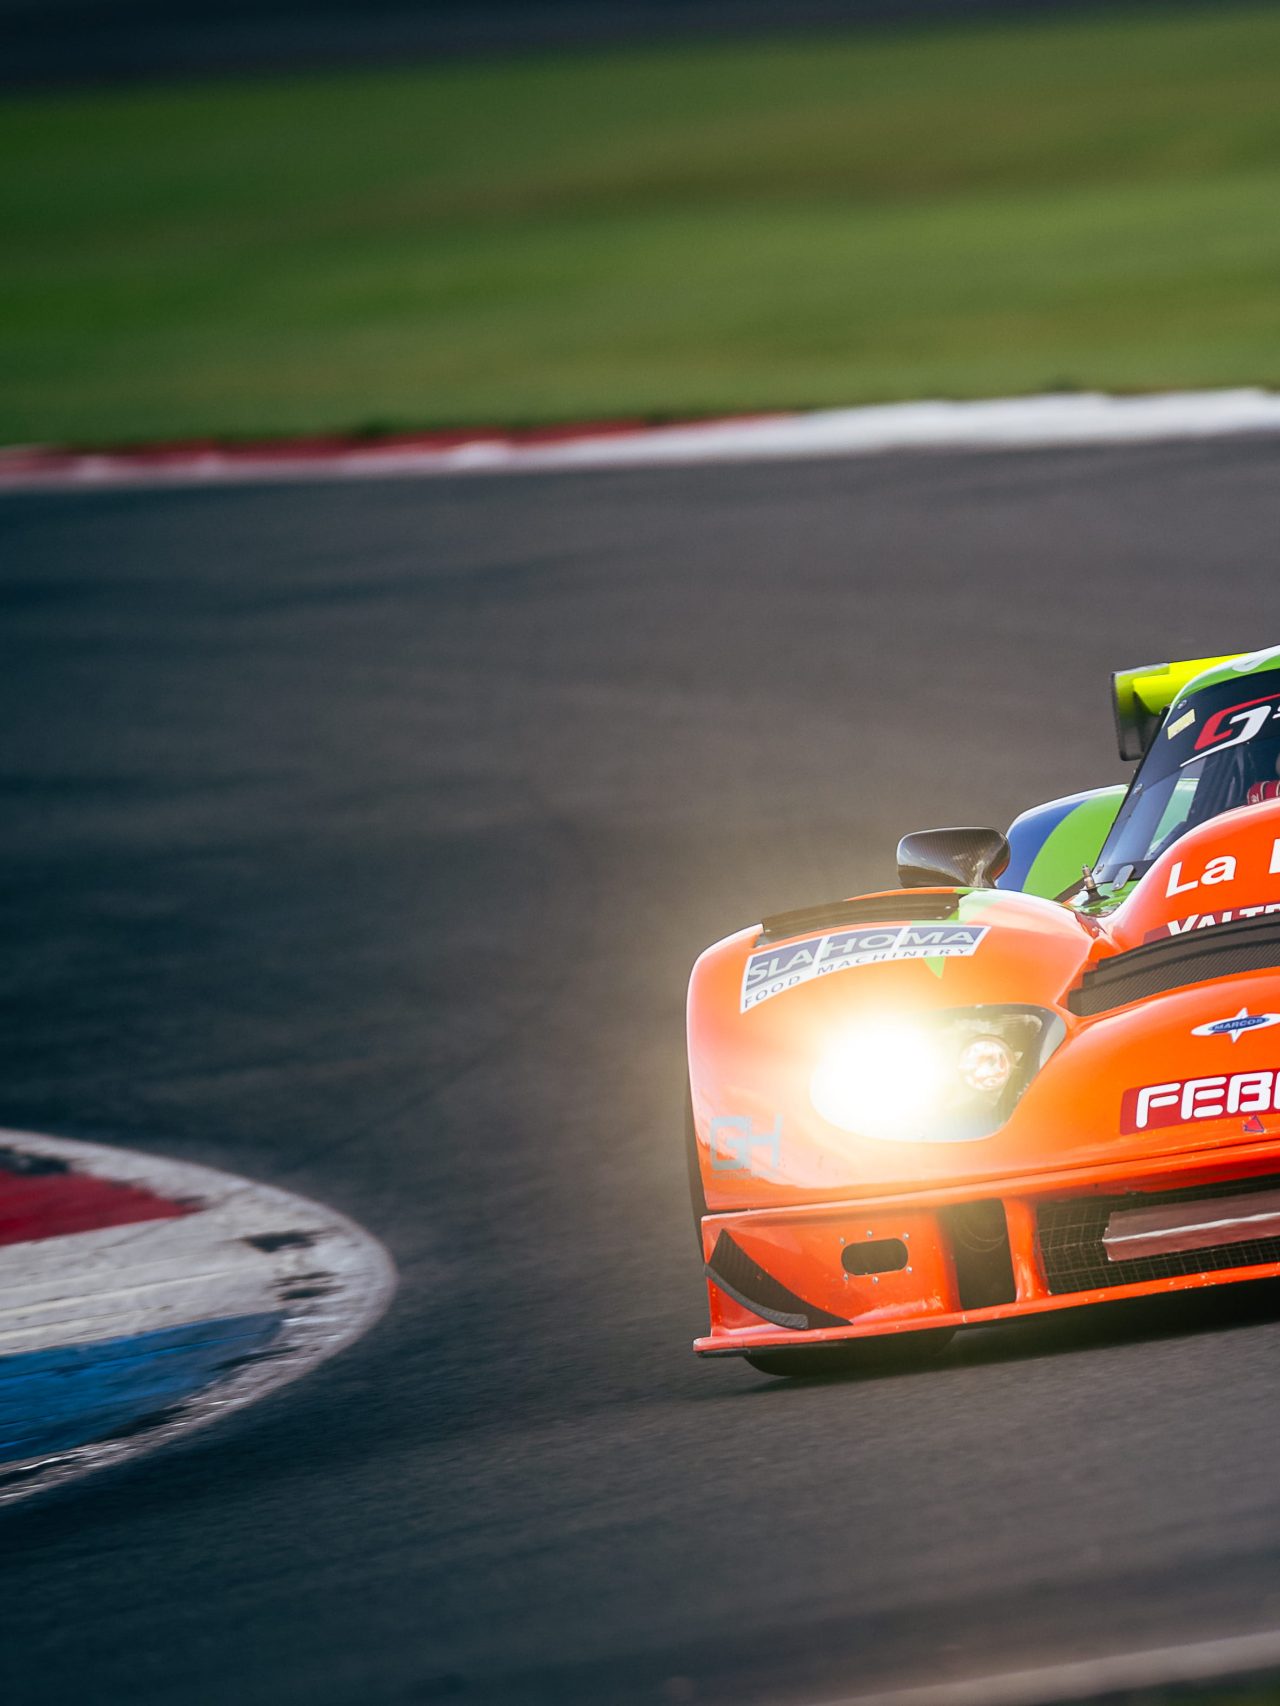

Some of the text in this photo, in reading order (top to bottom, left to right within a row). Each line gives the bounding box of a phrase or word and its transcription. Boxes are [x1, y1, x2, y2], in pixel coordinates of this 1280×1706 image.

[1165, 855, 1237, 898] La
[744, 946, 970, 1009] FOOD MACHINERY
[711, 1112, 784, 1171] GH
